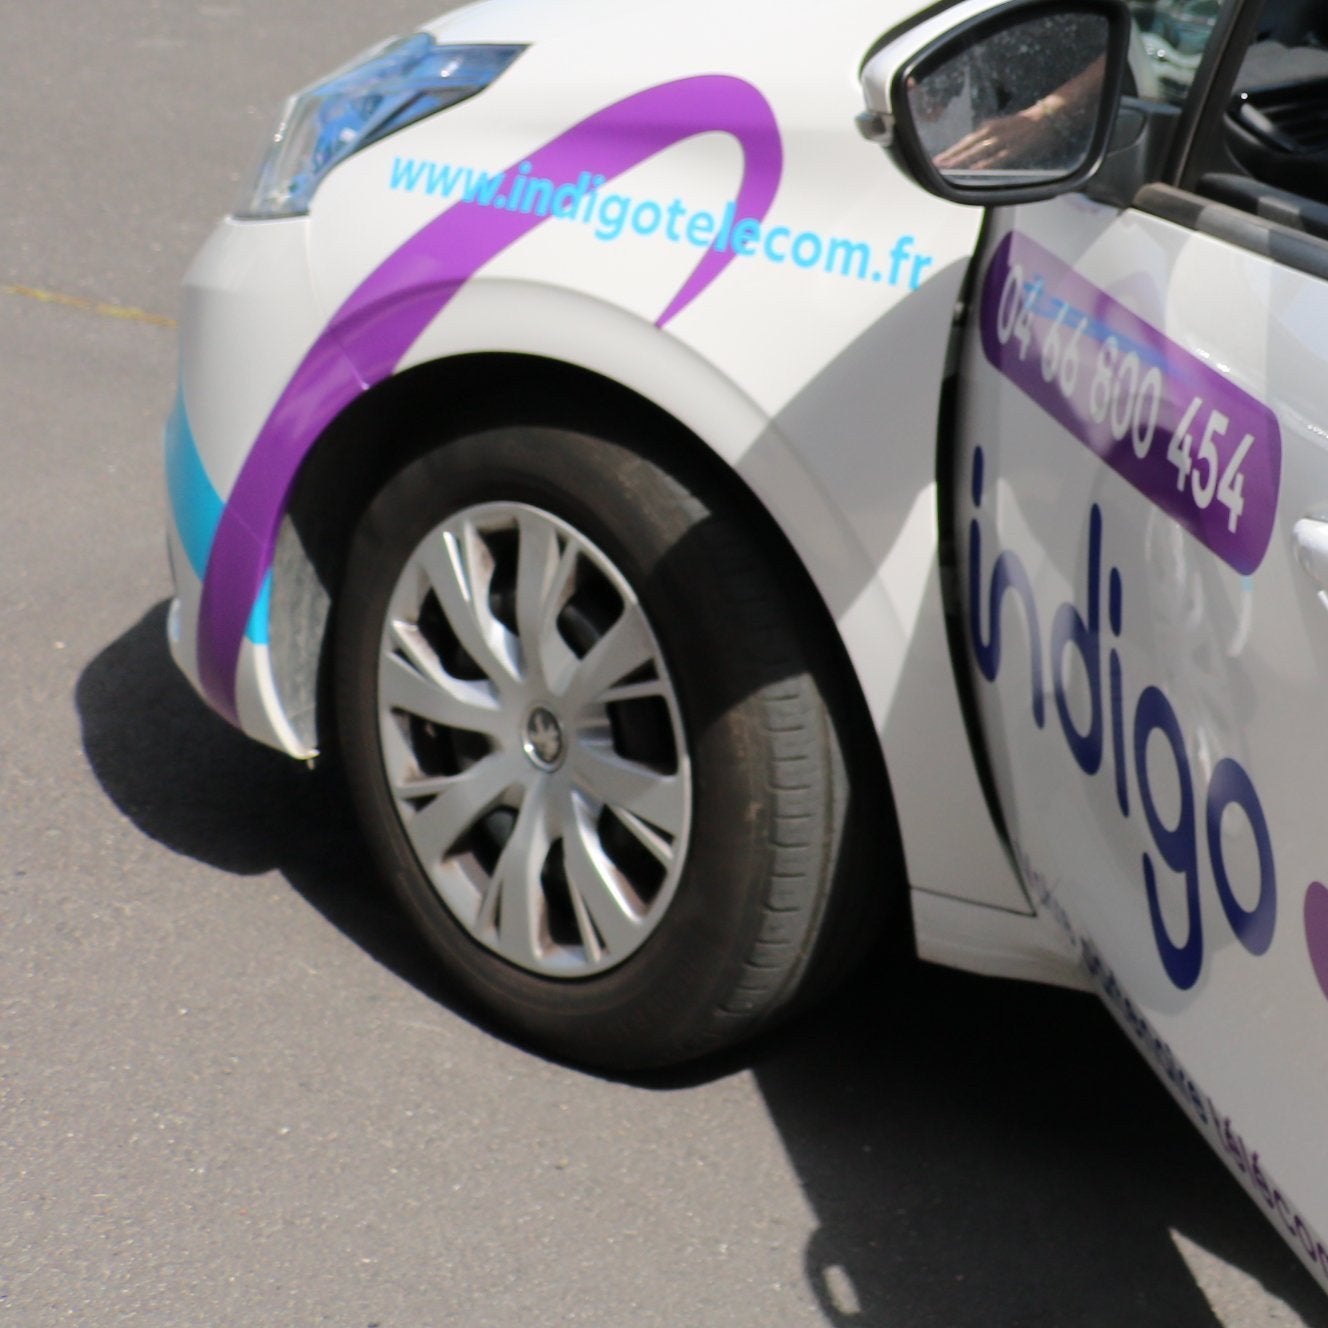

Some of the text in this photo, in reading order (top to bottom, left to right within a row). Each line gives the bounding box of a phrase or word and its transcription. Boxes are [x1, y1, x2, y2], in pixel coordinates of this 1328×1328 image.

[389, 155, 936, 293] www.indigotelecom.fr
[997, 264, 1255, 534] 04 66 800 454
[969, 445, 1277, 992] indigo
